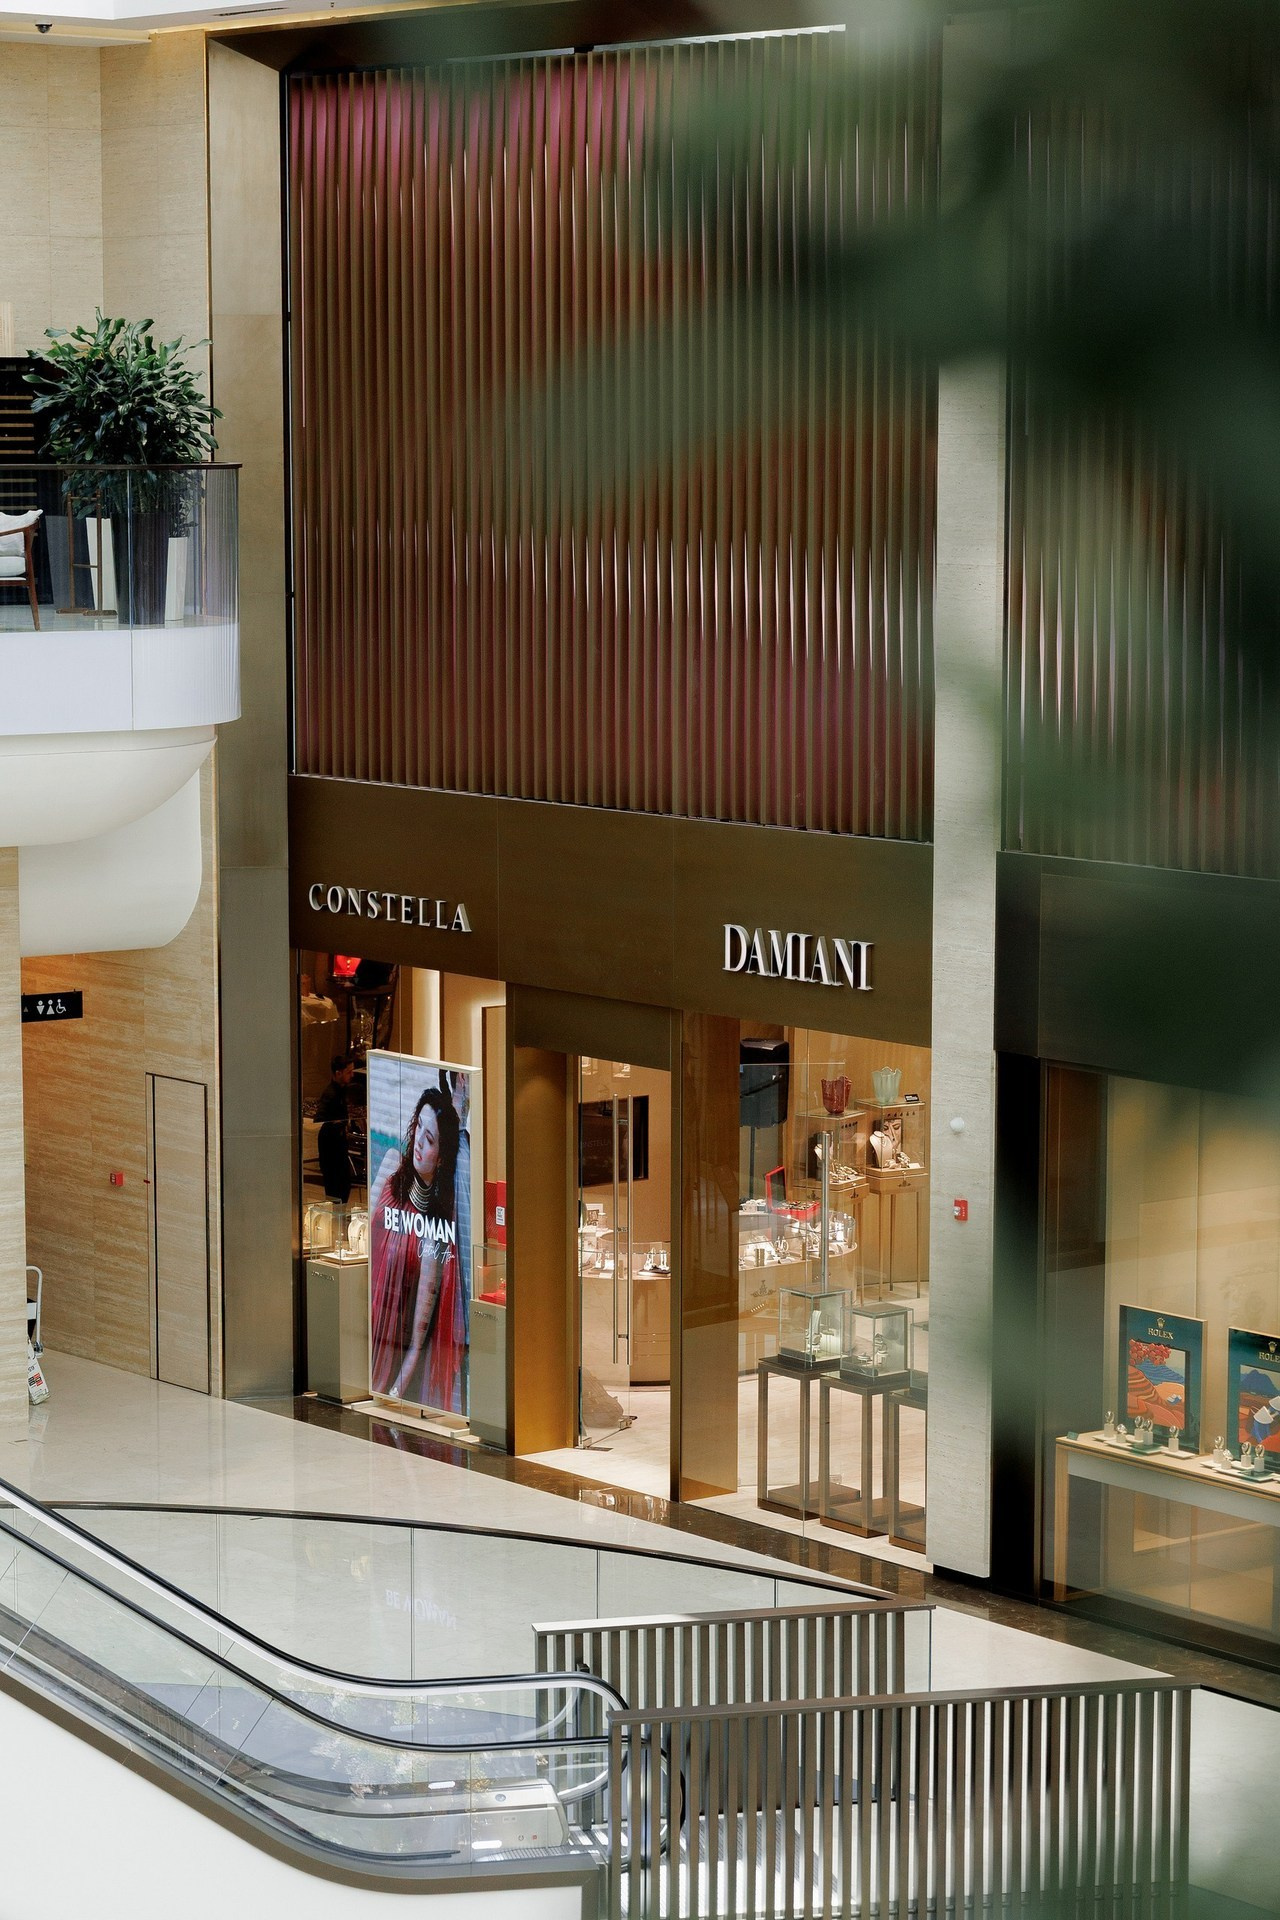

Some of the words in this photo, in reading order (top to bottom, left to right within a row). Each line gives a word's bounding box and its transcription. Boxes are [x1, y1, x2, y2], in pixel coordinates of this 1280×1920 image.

[308, 883, 473, 932] CONSTELLA
[722, 923, 875, 991] DAMIANI
[384, 1205, 400, 1232] BE
[400, 1210, 456, 1246] WOMAN
[1148, 1327, 1174, 1340] ROLEX
